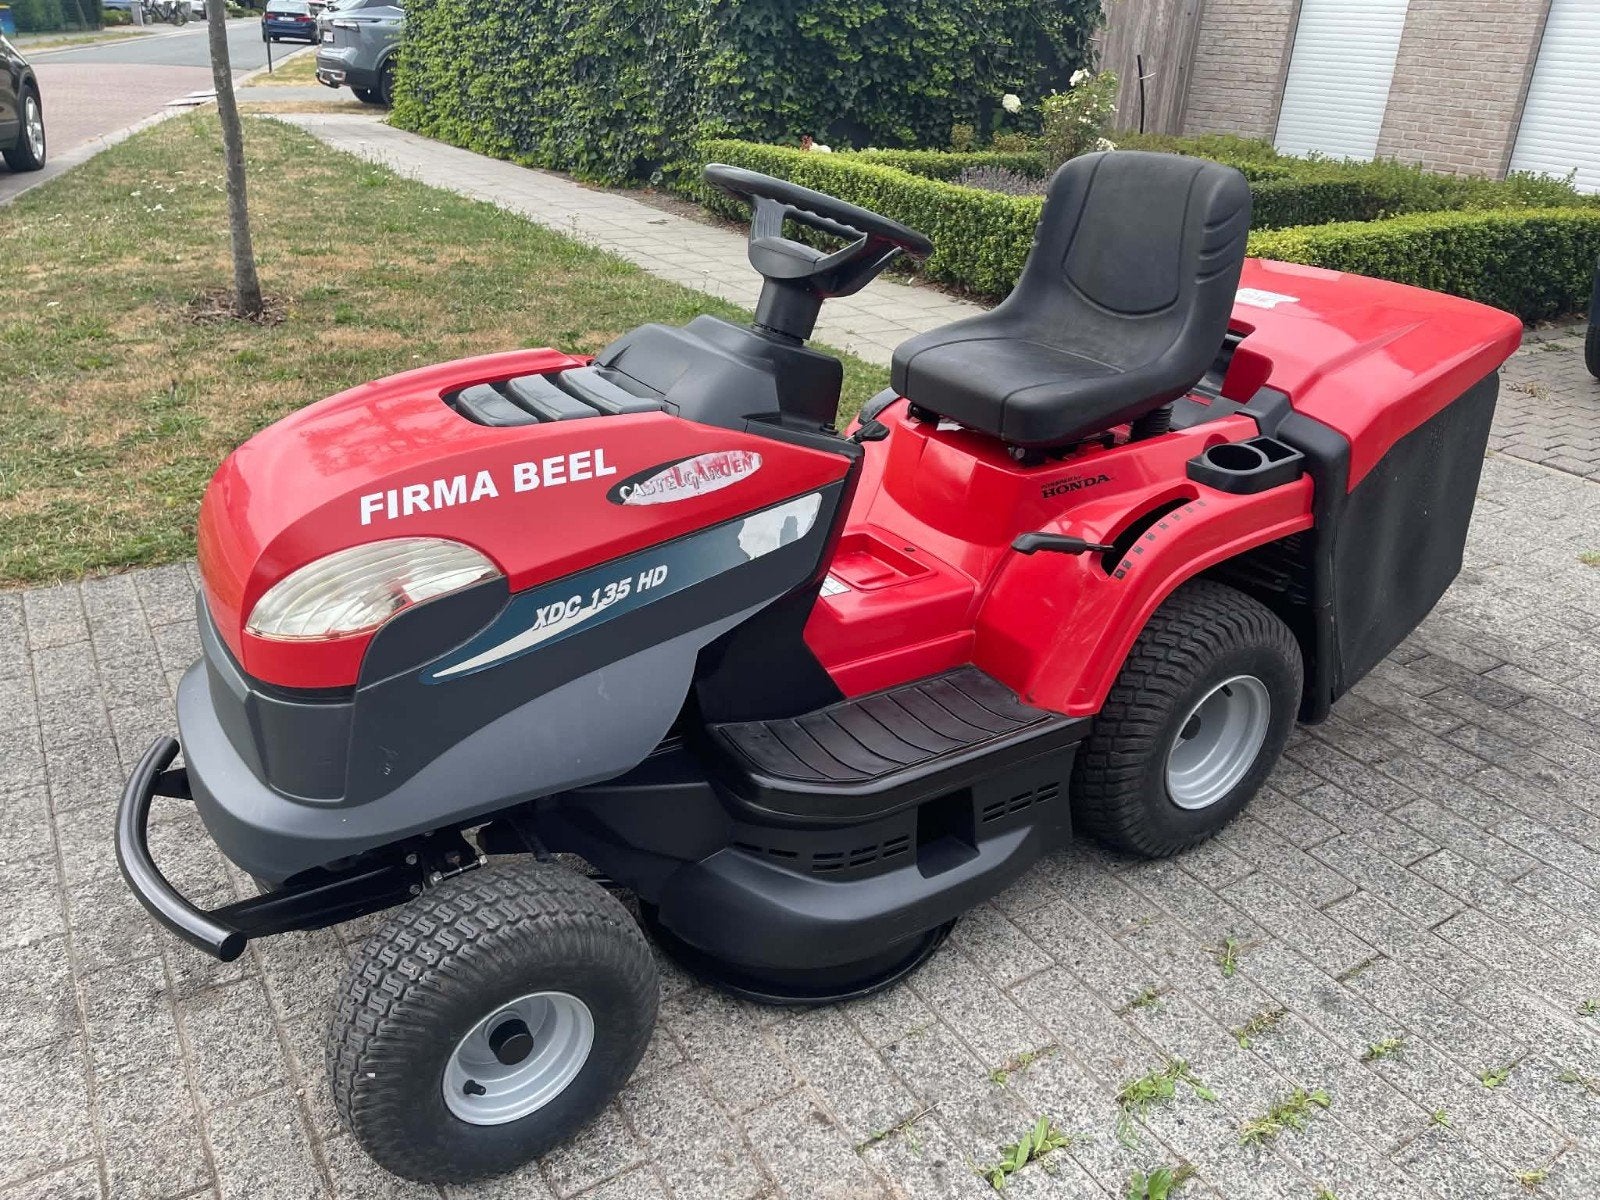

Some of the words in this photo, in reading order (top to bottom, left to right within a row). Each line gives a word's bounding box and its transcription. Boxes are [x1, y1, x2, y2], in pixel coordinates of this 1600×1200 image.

[360, 469, 499, 526] FIRMA
[513, 448, 617, 493] BEEL
[1042, 474, 1111, 499] HONDA
[533, 595, 582, 632] XDC
[590, 577, 632, 611] 135
[636, 564, 669, 594] HD
